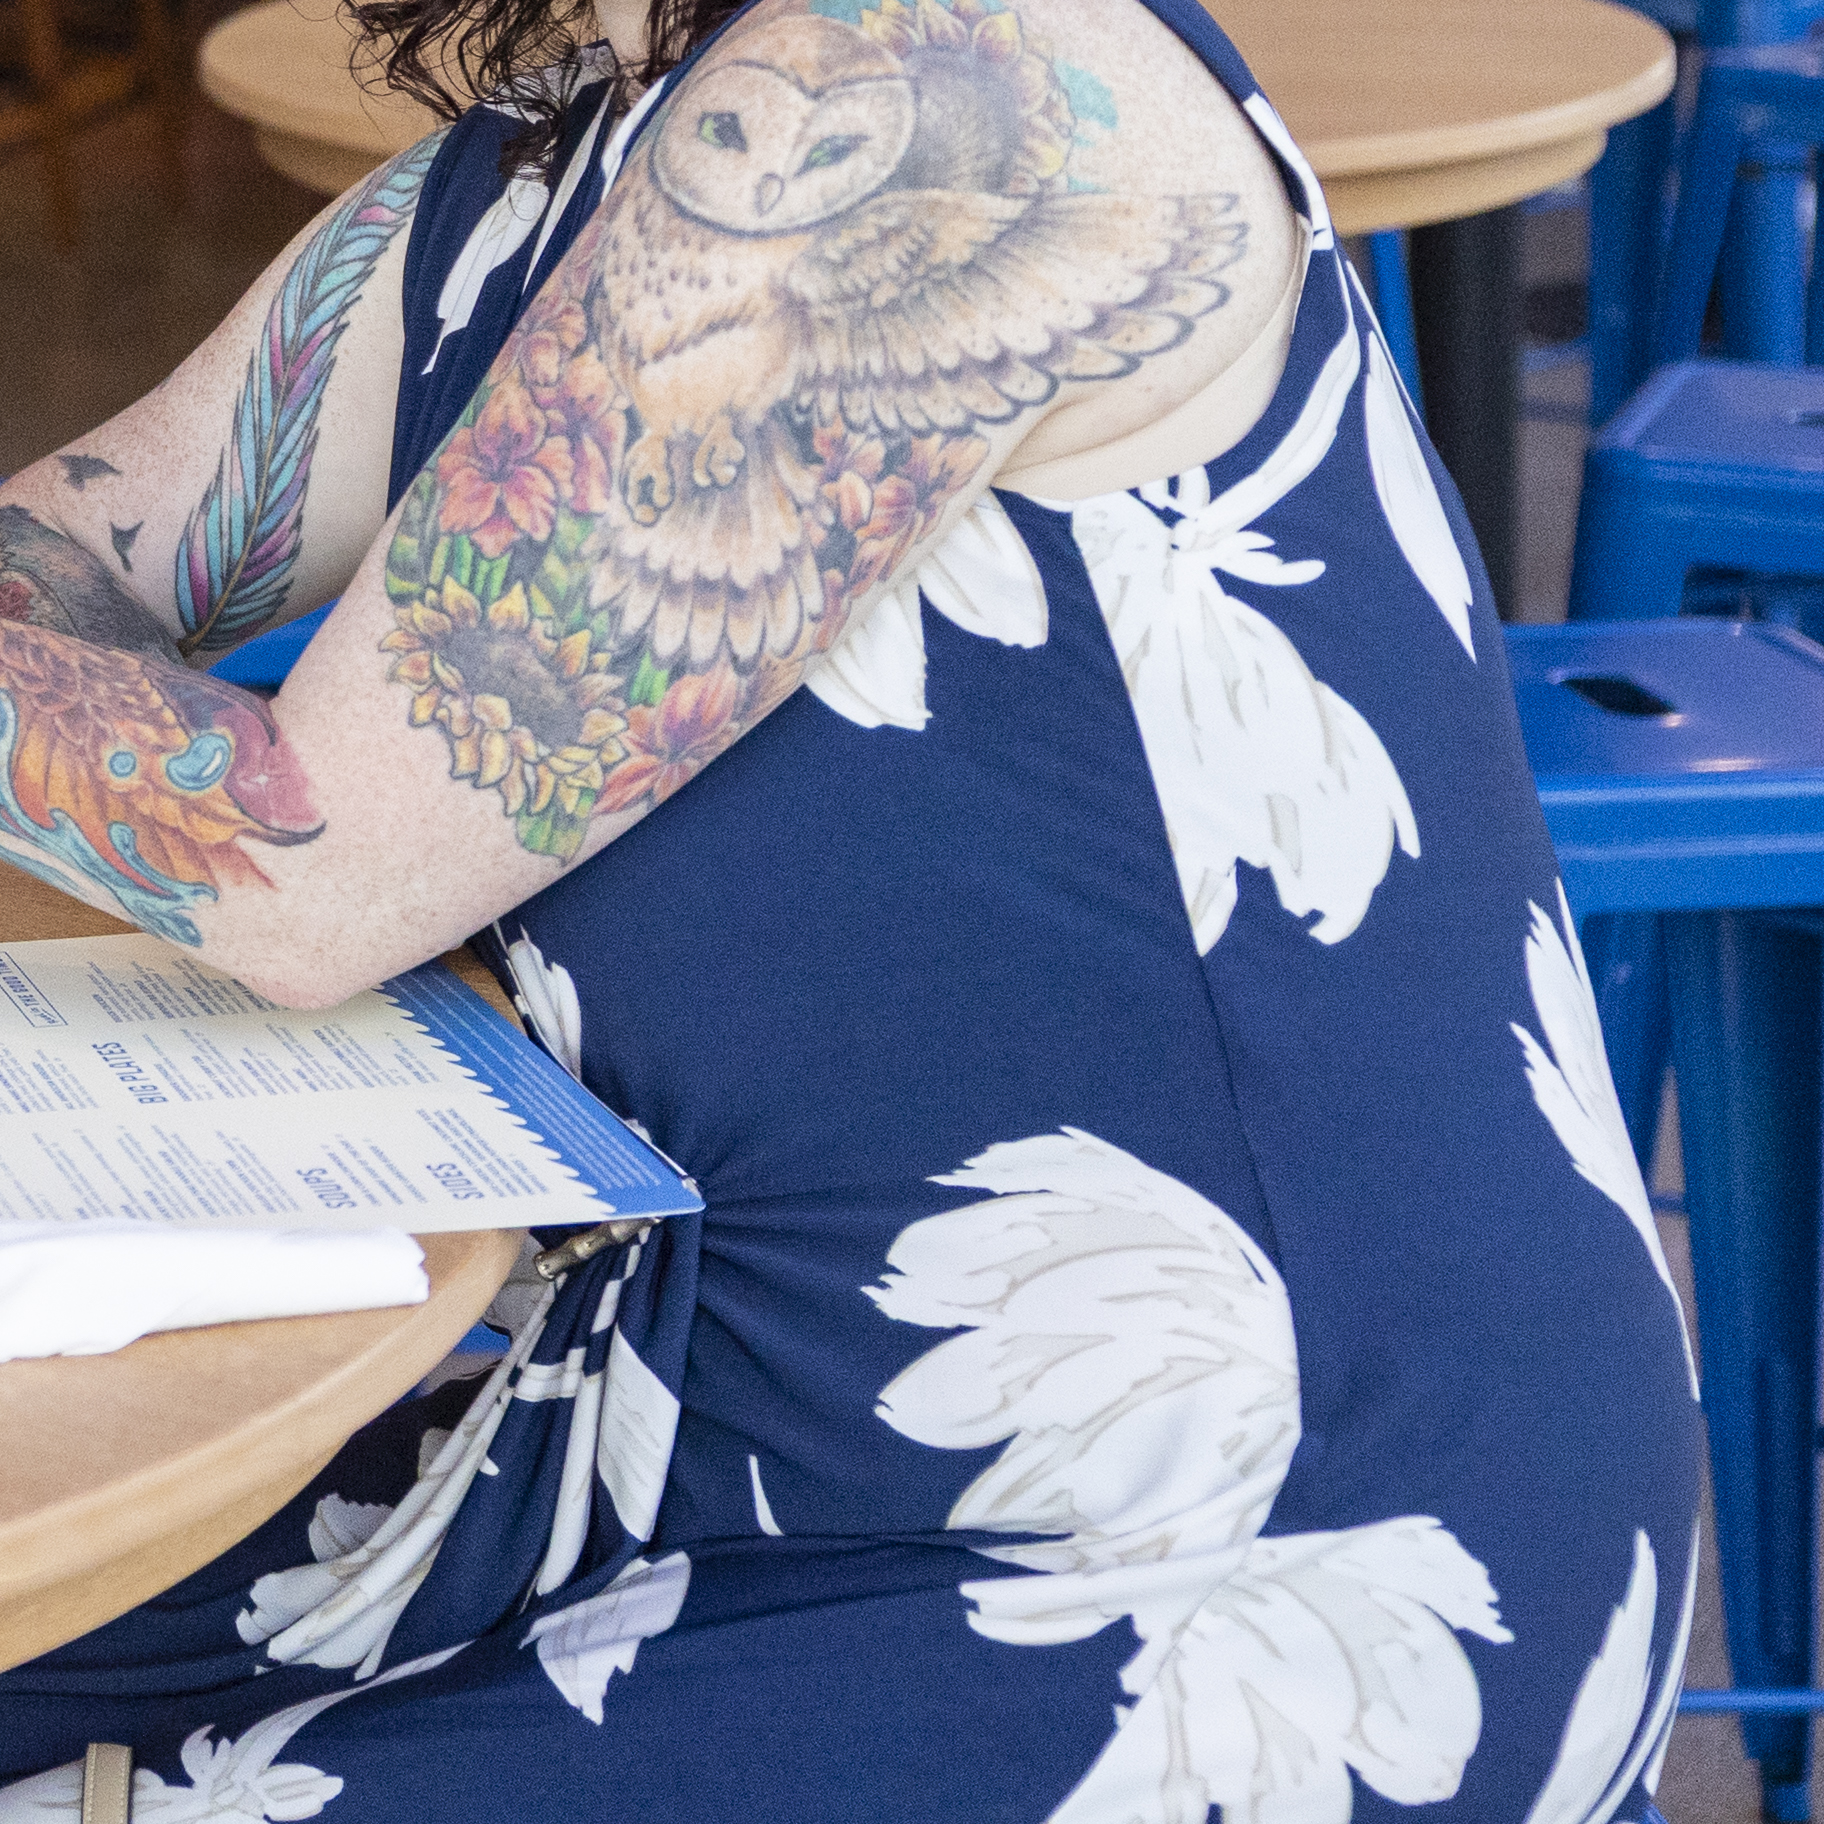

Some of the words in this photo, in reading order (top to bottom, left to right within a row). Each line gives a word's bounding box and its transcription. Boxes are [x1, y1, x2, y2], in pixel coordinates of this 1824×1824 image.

[1, 975, 29, 992] GOOD
[16, 994, 40, 1006] THE
[89, 1041, 151, 1081] PLATES
[126, 1084, 170, 1104] BIG
[293, 1167, 360, 1209] SOUPS
[422, 1162, 487, 1200] SIDES
